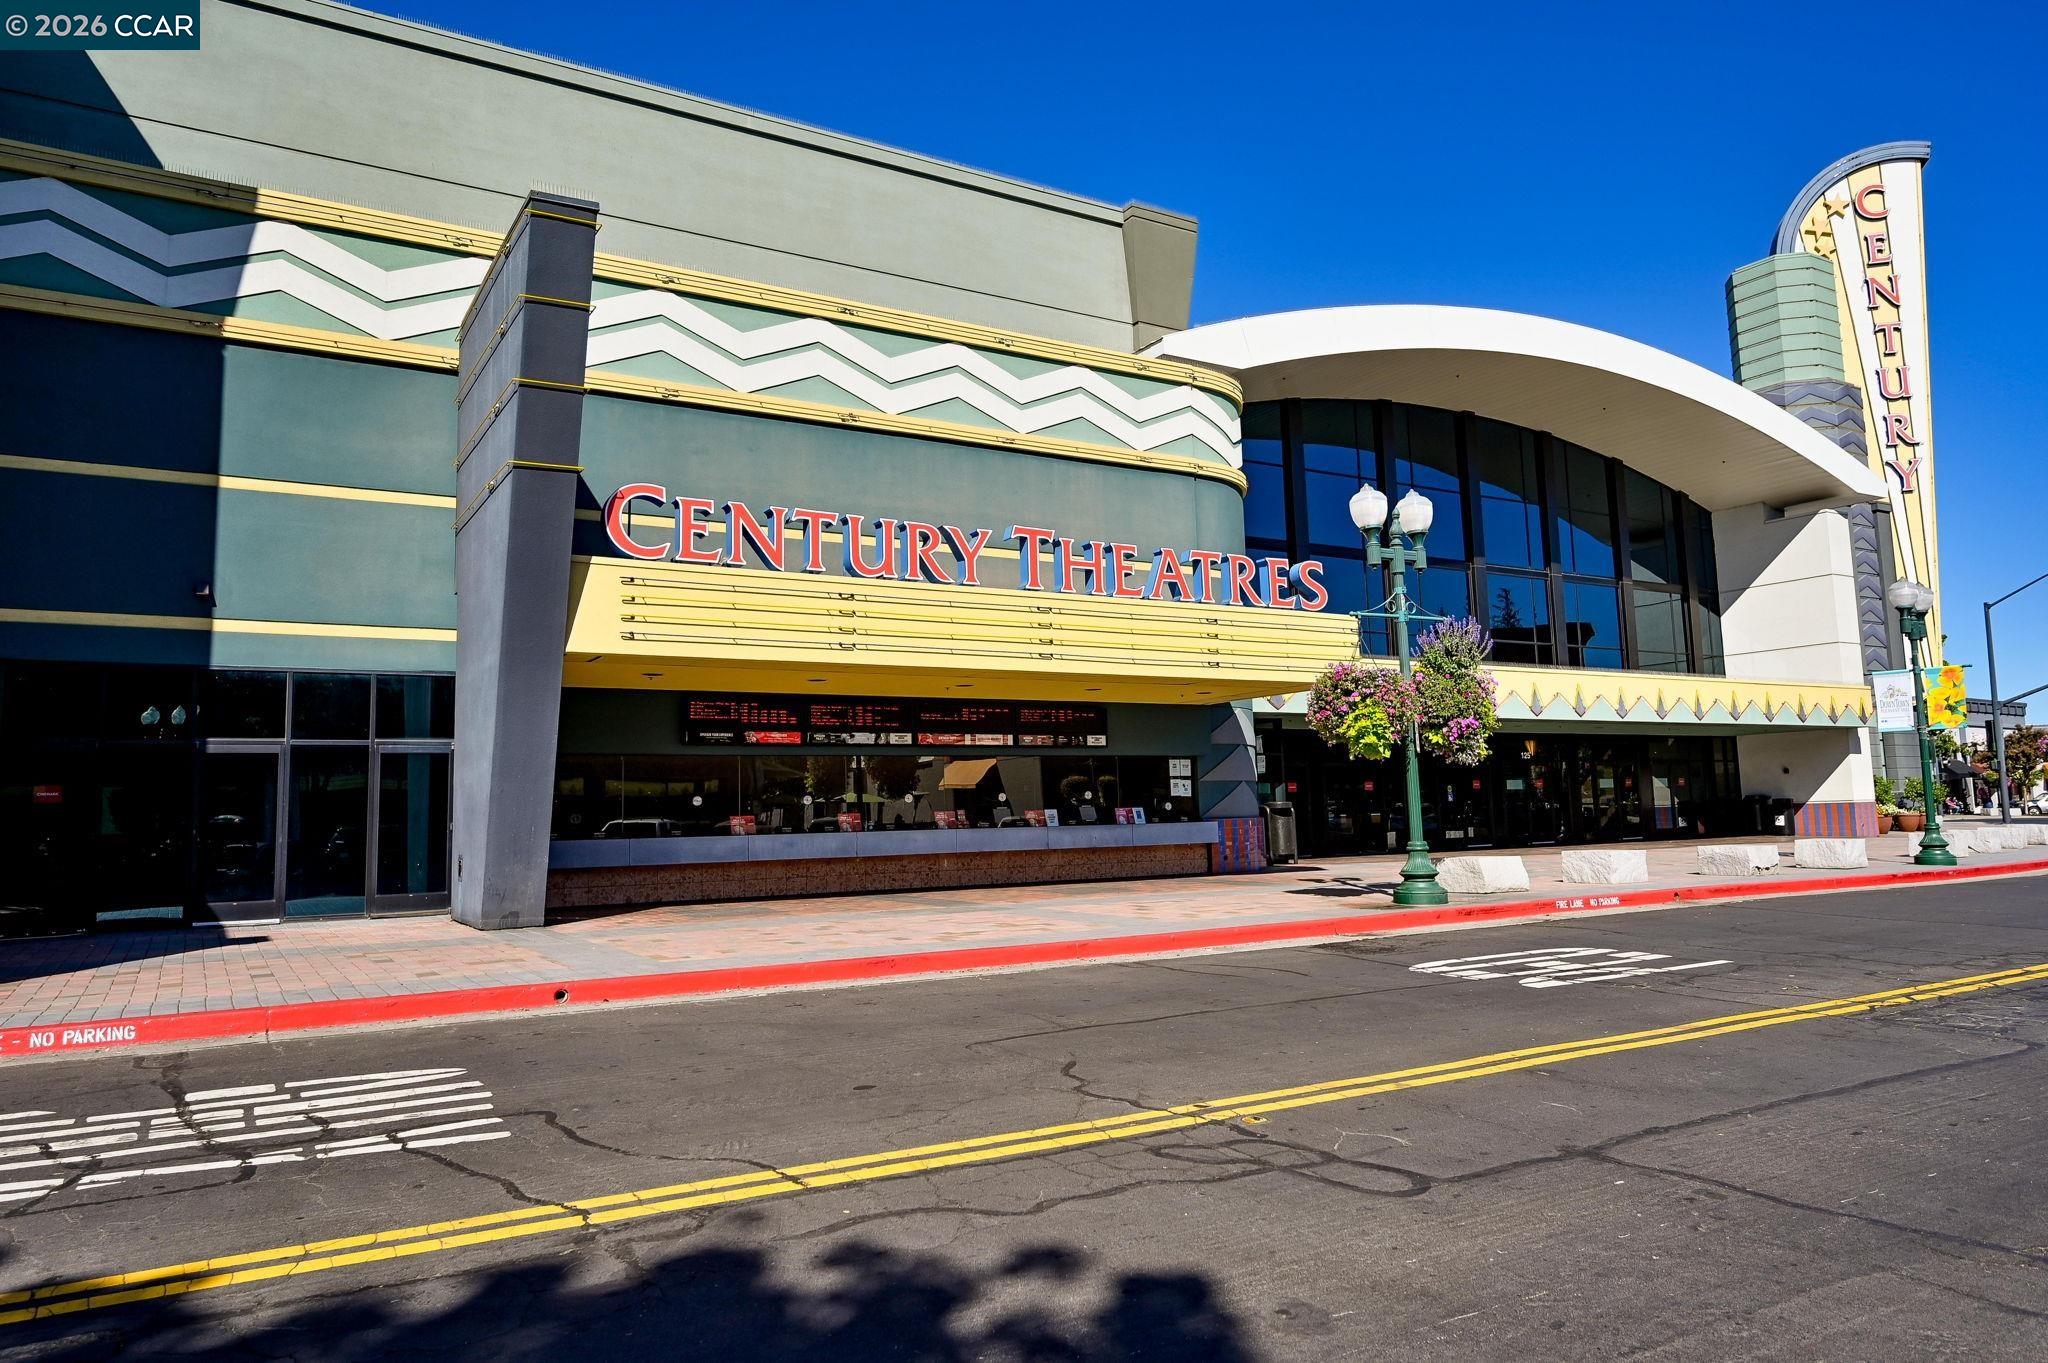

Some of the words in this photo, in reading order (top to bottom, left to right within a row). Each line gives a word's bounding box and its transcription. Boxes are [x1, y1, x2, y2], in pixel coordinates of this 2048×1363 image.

[1854, 184, 1921, 492] CENTURY
[603, 482, 992, 586] CENTURY
[1008, 524, 1329, 612] THEATRES
[1555, 900, 1569, 909] FIRE
[1570, 899, 1584, 908] LANE
[1589, 898, 1598, 907] NO
[1598, 896, 1620, 907] PARKING
[29, 1032, 55, 1048] NO
[62, 1025, 136, 1045] PARKING
